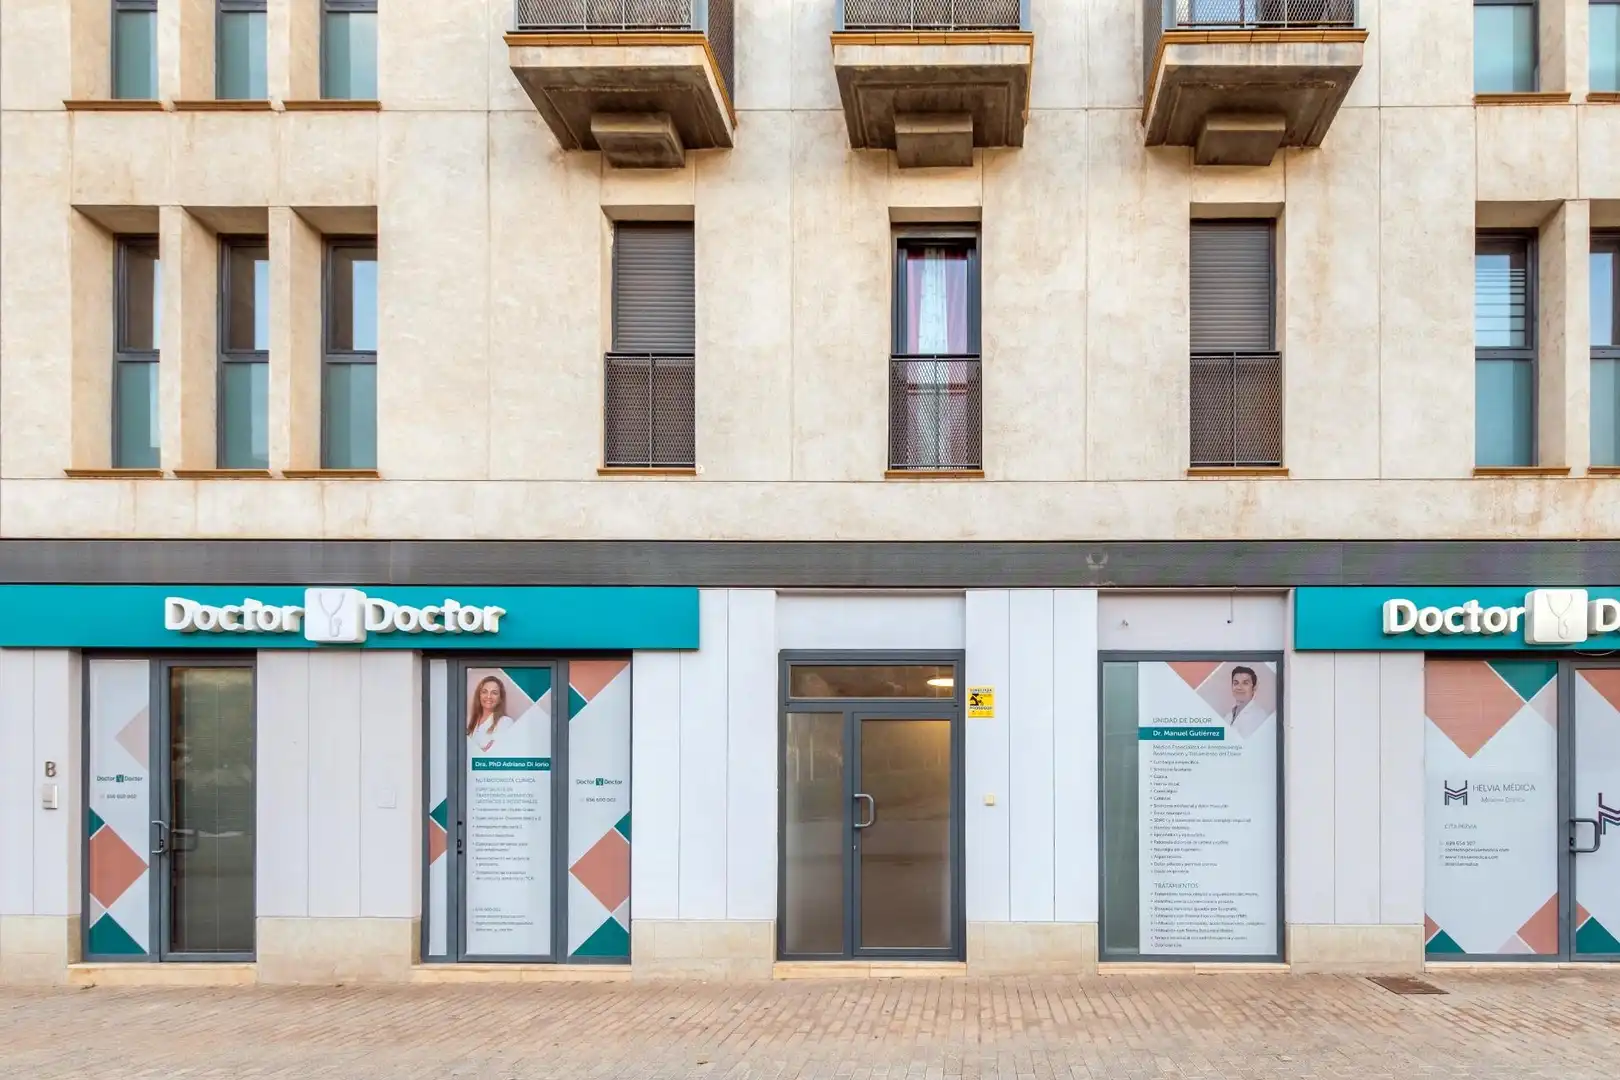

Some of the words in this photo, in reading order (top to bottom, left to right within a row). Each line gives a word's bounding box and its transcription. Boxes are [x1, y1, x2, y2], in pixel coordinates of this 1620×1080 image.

[165, 597, 304, 633] Doctor
[365, 598, 506, 634] Doctor
[1383, 598, 1525, 635] Doctor
[1588, 598, 1620, 635] D
[1189, 729, 1220, 738] Gutiérrez
[45, 761, 57, 777] B
[1472, 783, 1500, 792] HELVIA
[1502, 782, 1536, 792] MÉDICA
